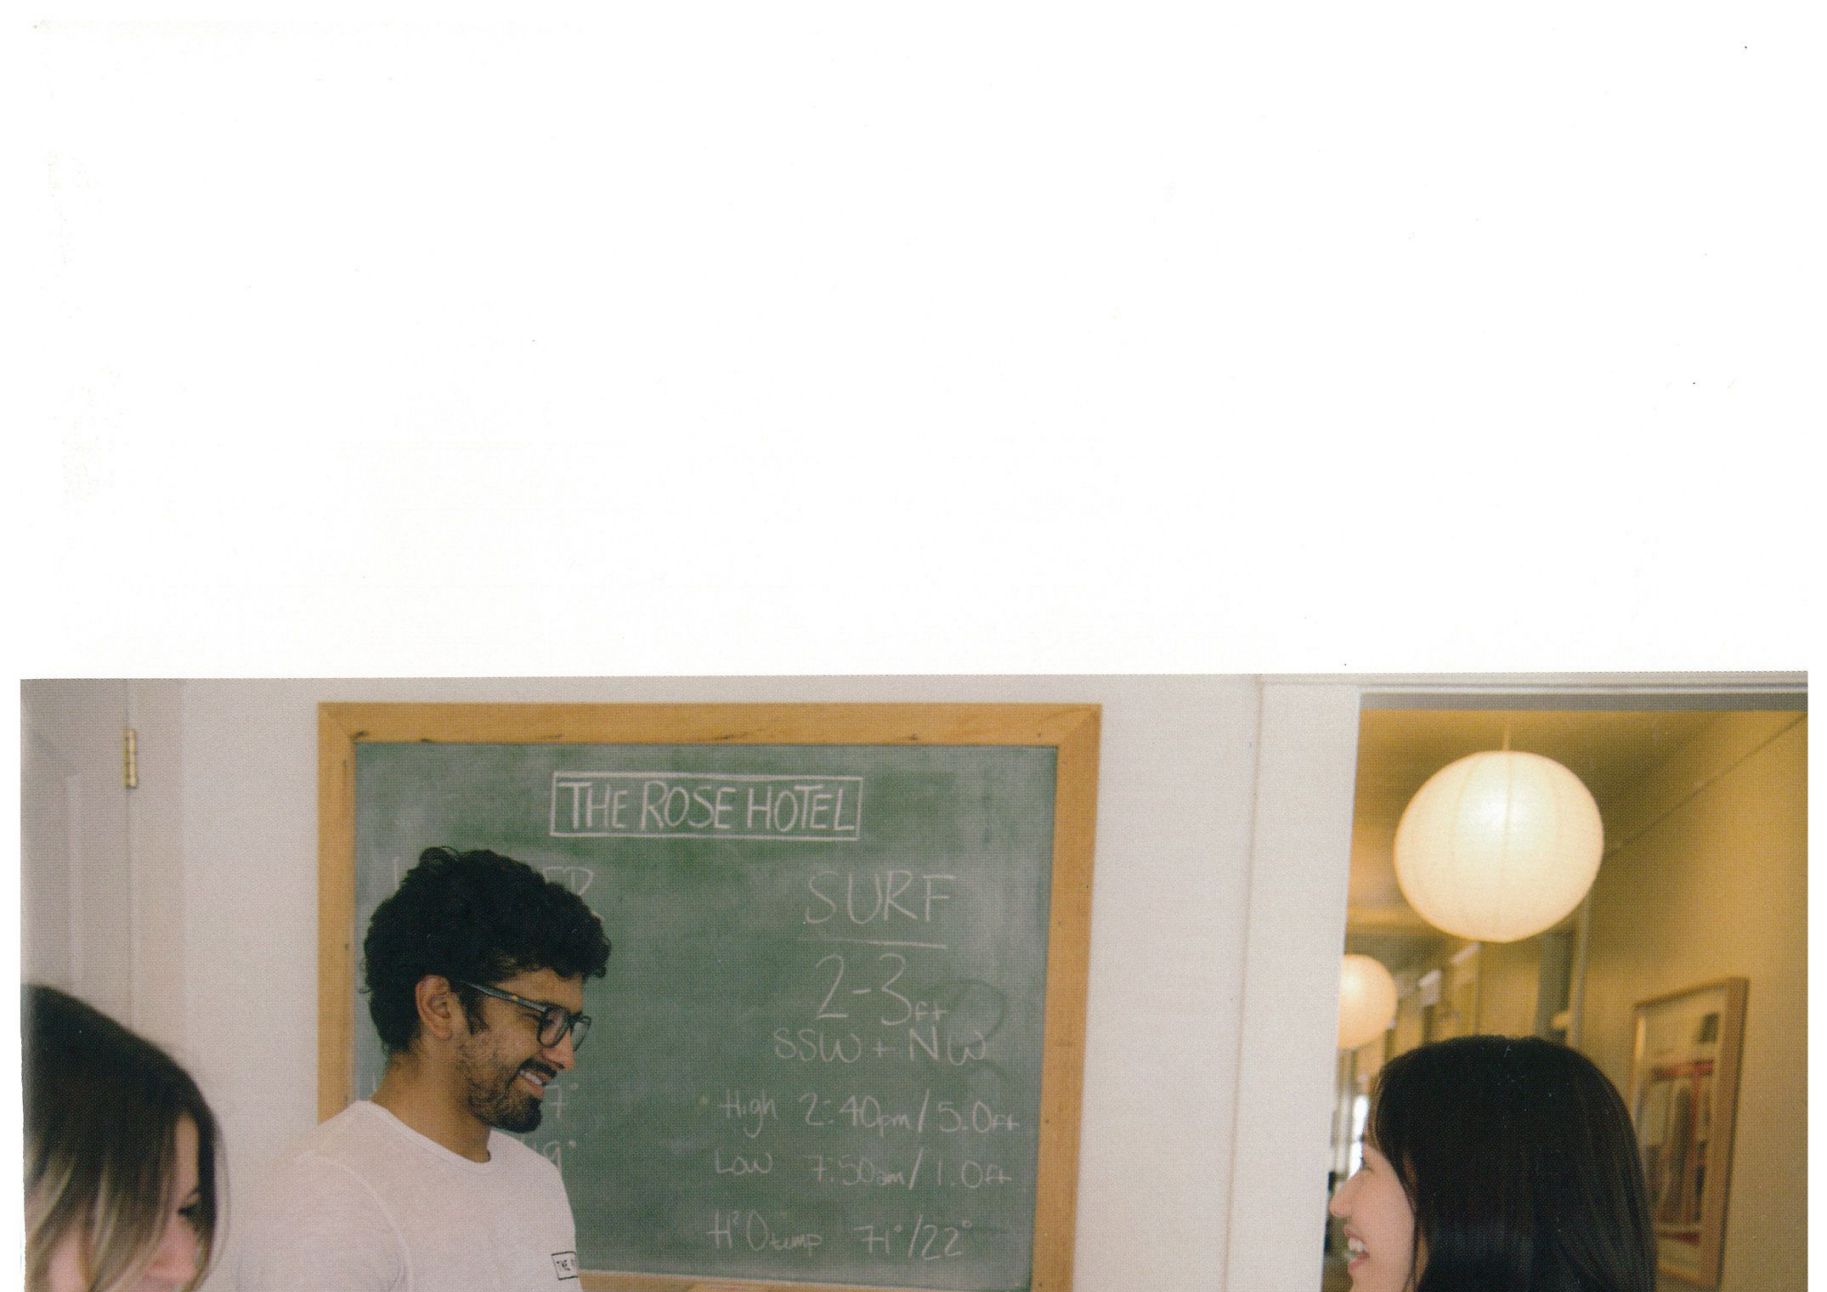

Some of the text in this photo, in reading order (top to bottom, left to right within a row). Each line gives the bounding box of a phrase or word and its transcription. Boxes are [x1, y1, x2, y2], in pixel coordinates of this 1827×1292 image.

[557, 780, 856, 832] THE ROSE HOTEL
[804, 870, 956, 925] SURF
[774, 1025, 986, 1066] SSW + NW
[719, 1088, 778, 1138] High
